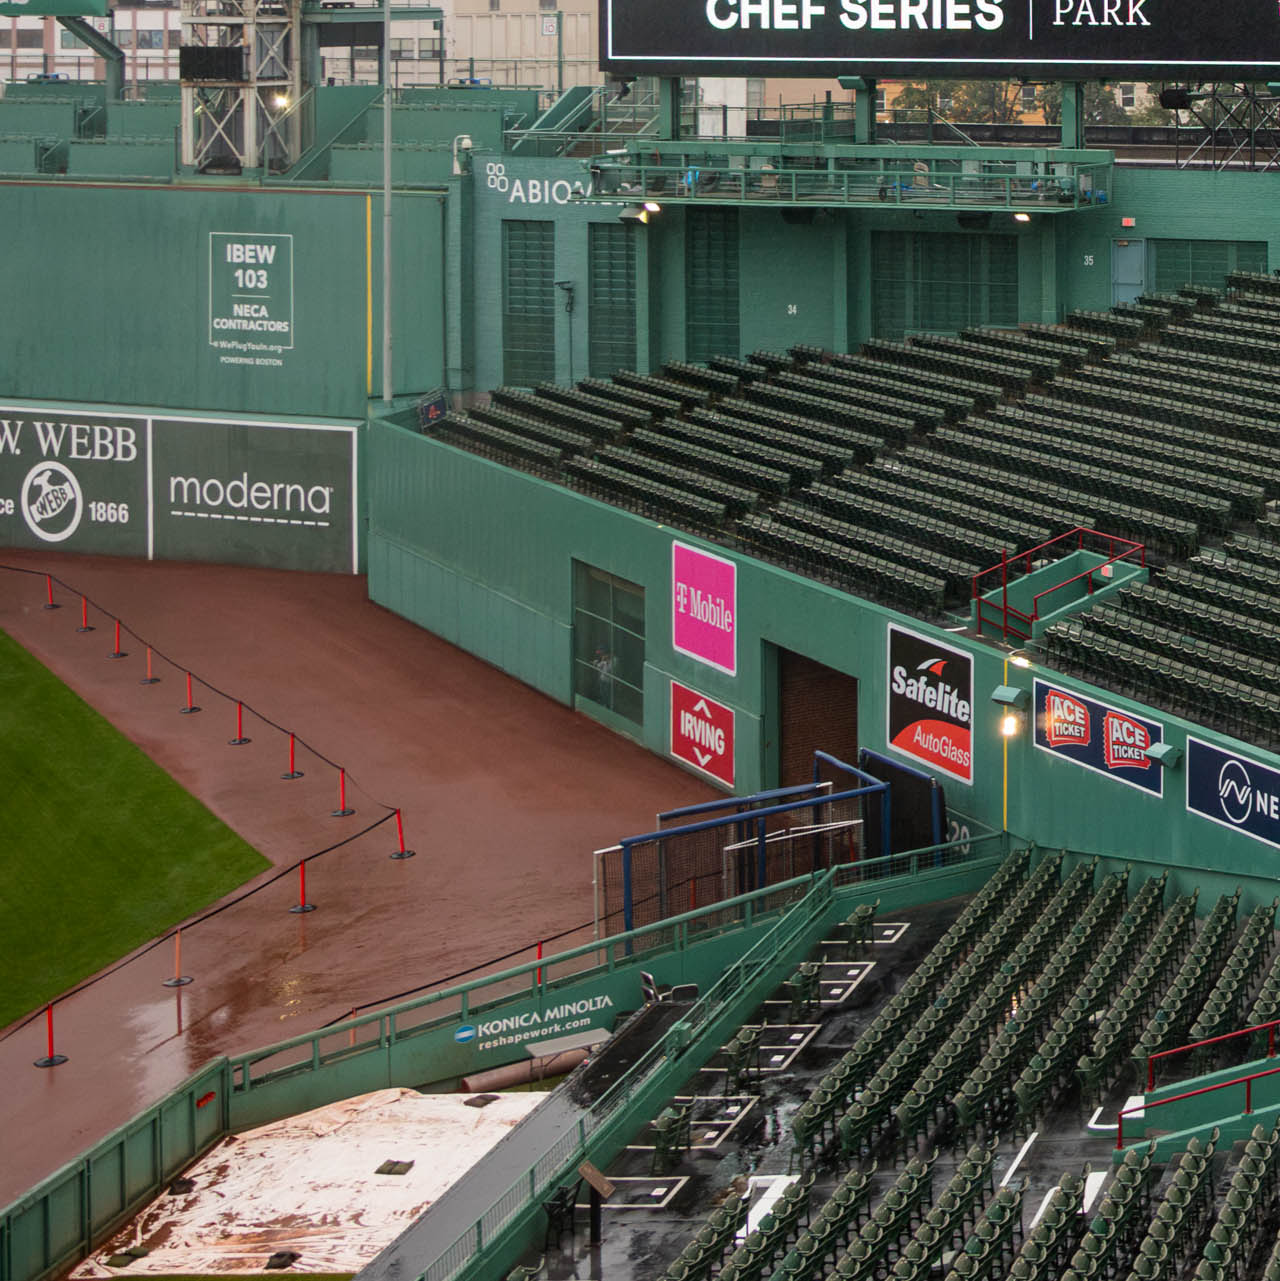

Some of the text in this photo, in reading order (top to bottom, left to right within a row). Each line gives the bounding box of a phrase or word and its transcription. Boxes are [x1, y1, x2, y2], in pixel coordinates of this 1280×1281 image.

[226, 243, 276, 265] IBEW
[1084, 255, 1094, 266] 35
[234, 269, 268, 289] 103
[232, 303, 269, 318] NECA
[787, 304, 797, 315] 34
[213, 318, 289, 332] CONTRACTORS
[32, 421, 137, 462] WEBB
[37, 487, 68, 517] WEBB
[169, 472, 330, 513] moderna
[88, 501, 129, 524] 1866
[690, 586, 733, 633] Mobile
[891, 664, 971, 724] Safelite
[1051, 694, 1086, 725] ACE
[680, 709, 726, 757] IRVING
[1054, 719, 1087, 739] TICKET
[1109, 718, 1146, 748] ACE
[913, 726, 971, 768] AutoGlass
[1111, 742, 1147, 763] TICKET
[946, 817, 970, 855] 20
[477, 995, 613, 1038] KONICA MINOLTA
[478, 1017, 592, 1051] reshapework.com
